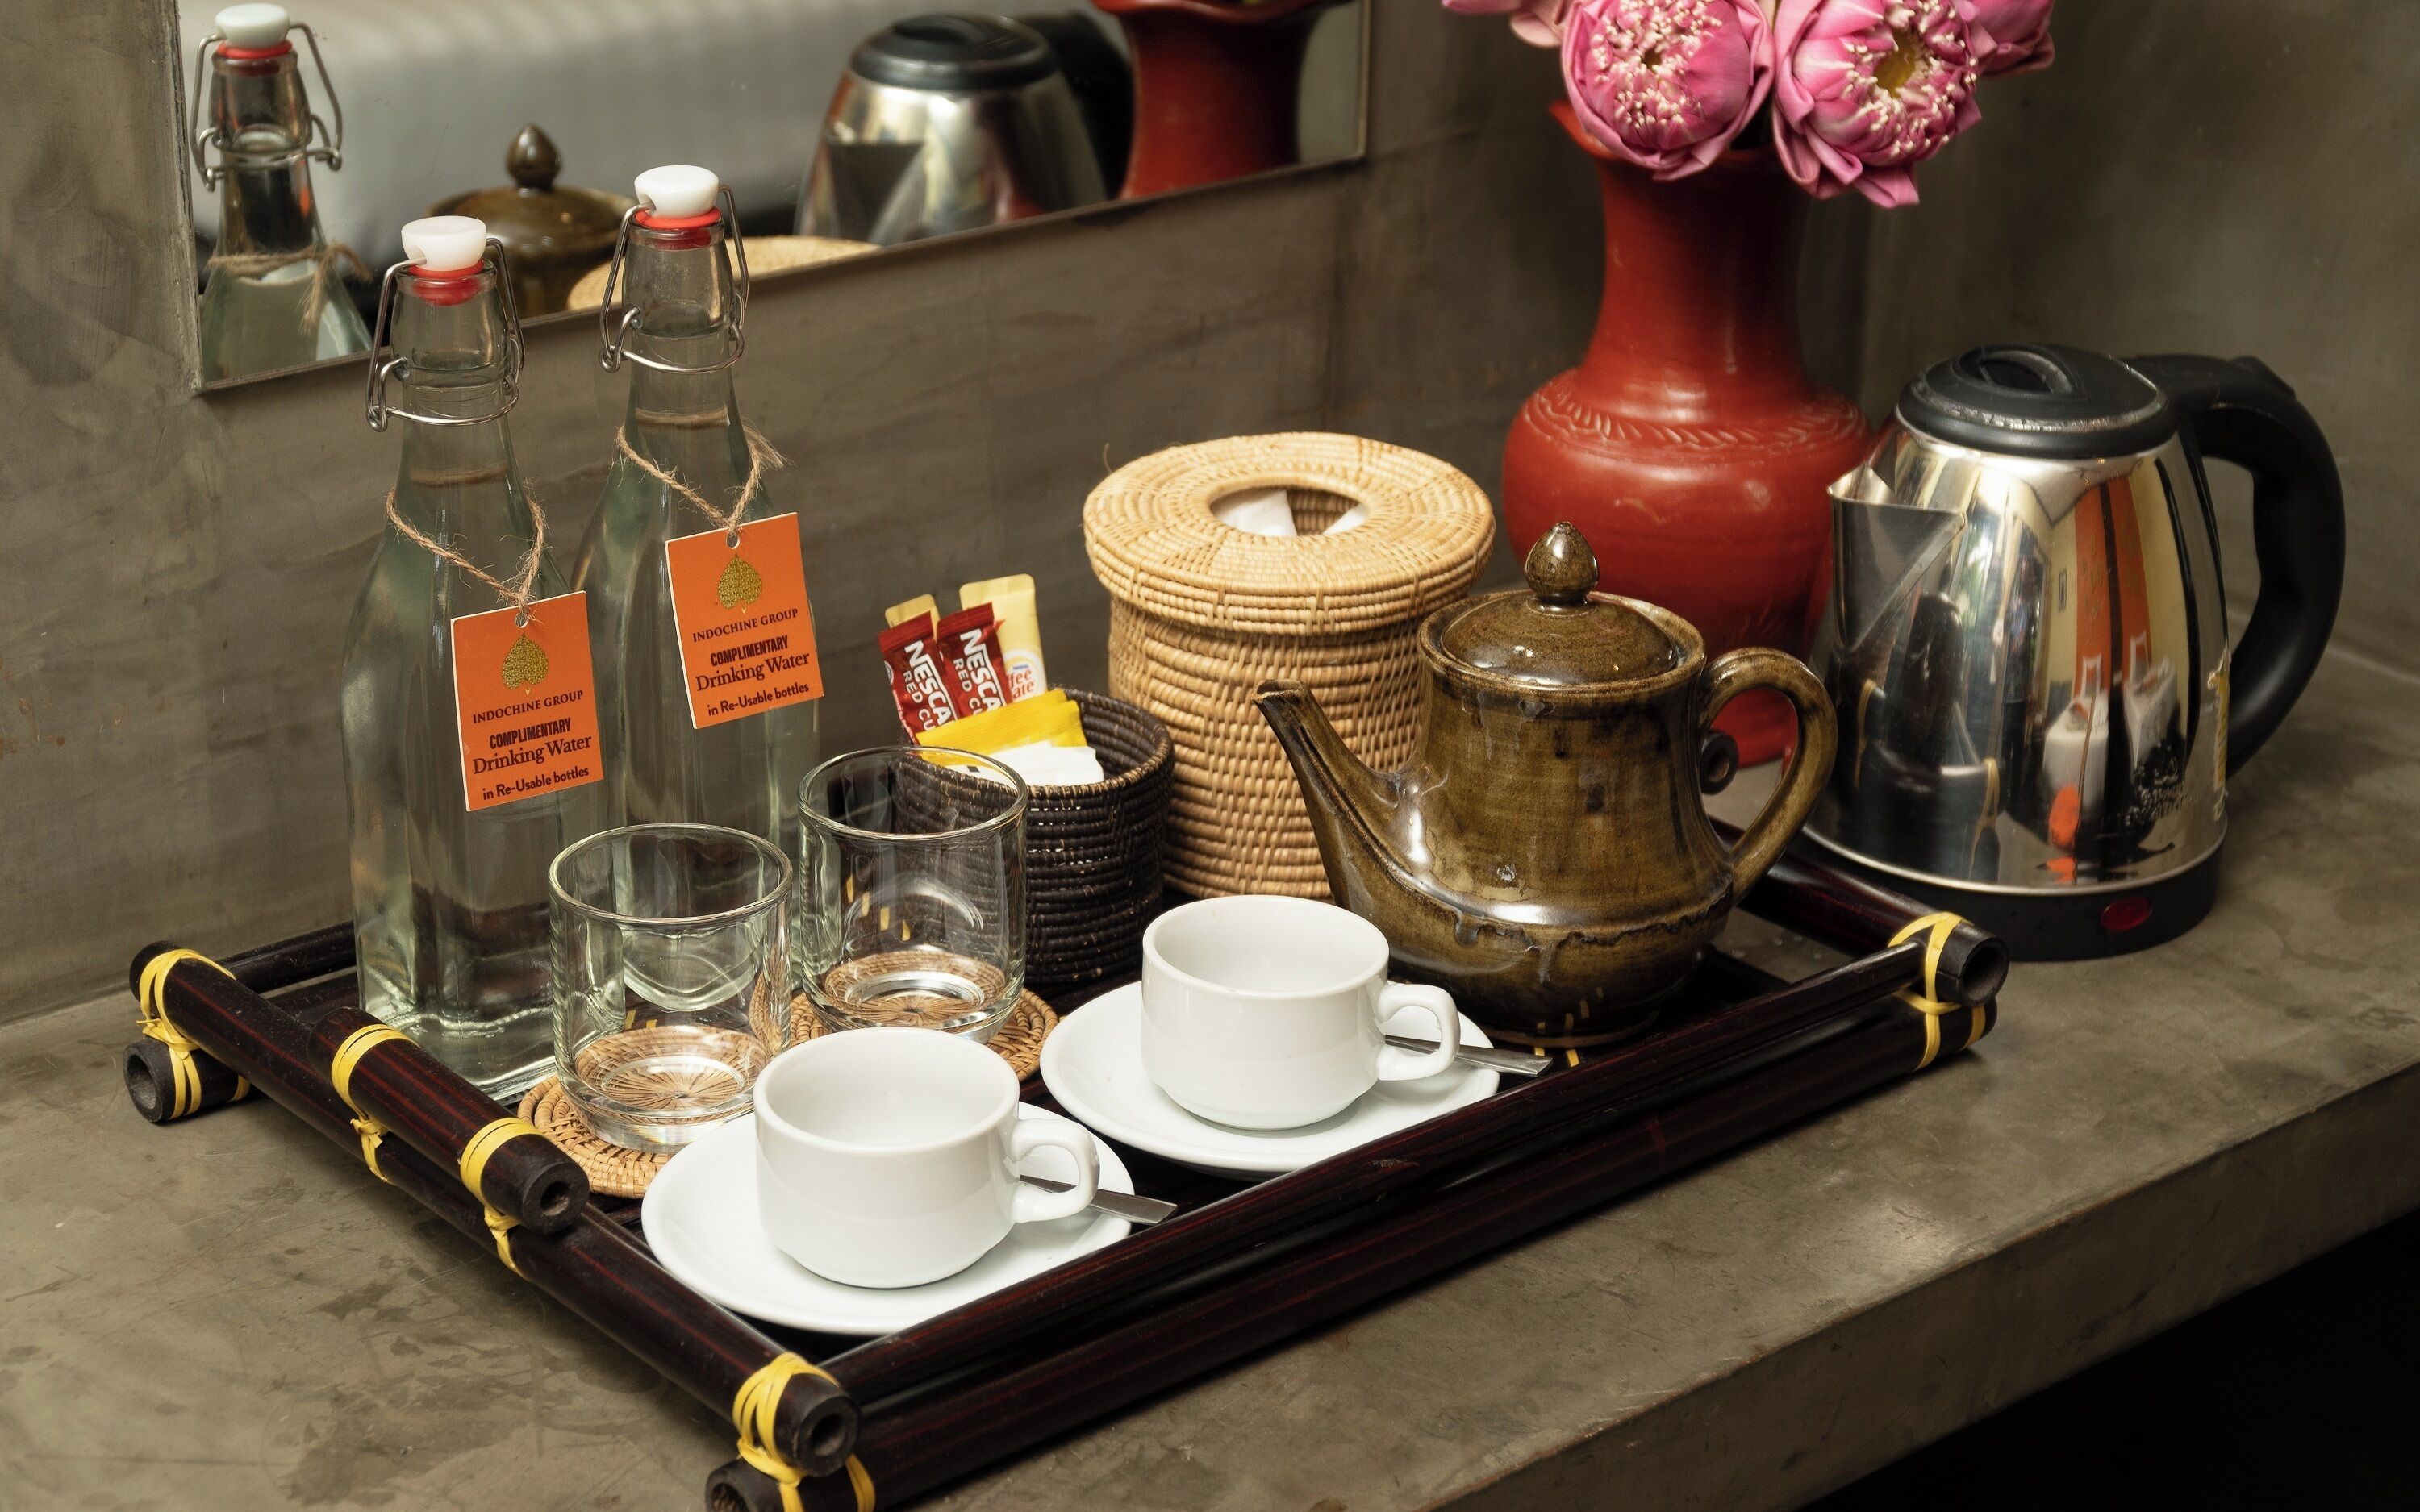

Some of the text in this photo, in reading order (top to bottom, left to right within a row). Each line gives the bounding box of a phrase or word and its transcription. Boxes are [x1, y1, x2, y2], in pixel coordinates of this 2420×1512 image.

[692, 608, 799, 642] INDOCHINE GROUP
[710, 635, 789, 667] COMPLIMENTARY
[695, 652, 810, 691] Drinking Water
[904, 640, 958, 725] NESCA
[953, 658, 973, 692] RED
[960, 628, 1007, 711] NESCA
[473, 690, 583, 723] INDOCHINE GROUP
[707, 682, 809, 716] in Re-Usable bottles
[903, 670, 924, 703] RED
[918, 708, 937, 731] CU
[1012, 681, 1034, 698] ate
[489, 718, 571, 749] COMPLIMENTARY
[473, 735, 592, 774] Drinking Water
[482, 765, 590, 800] in Re-Usable bottles
